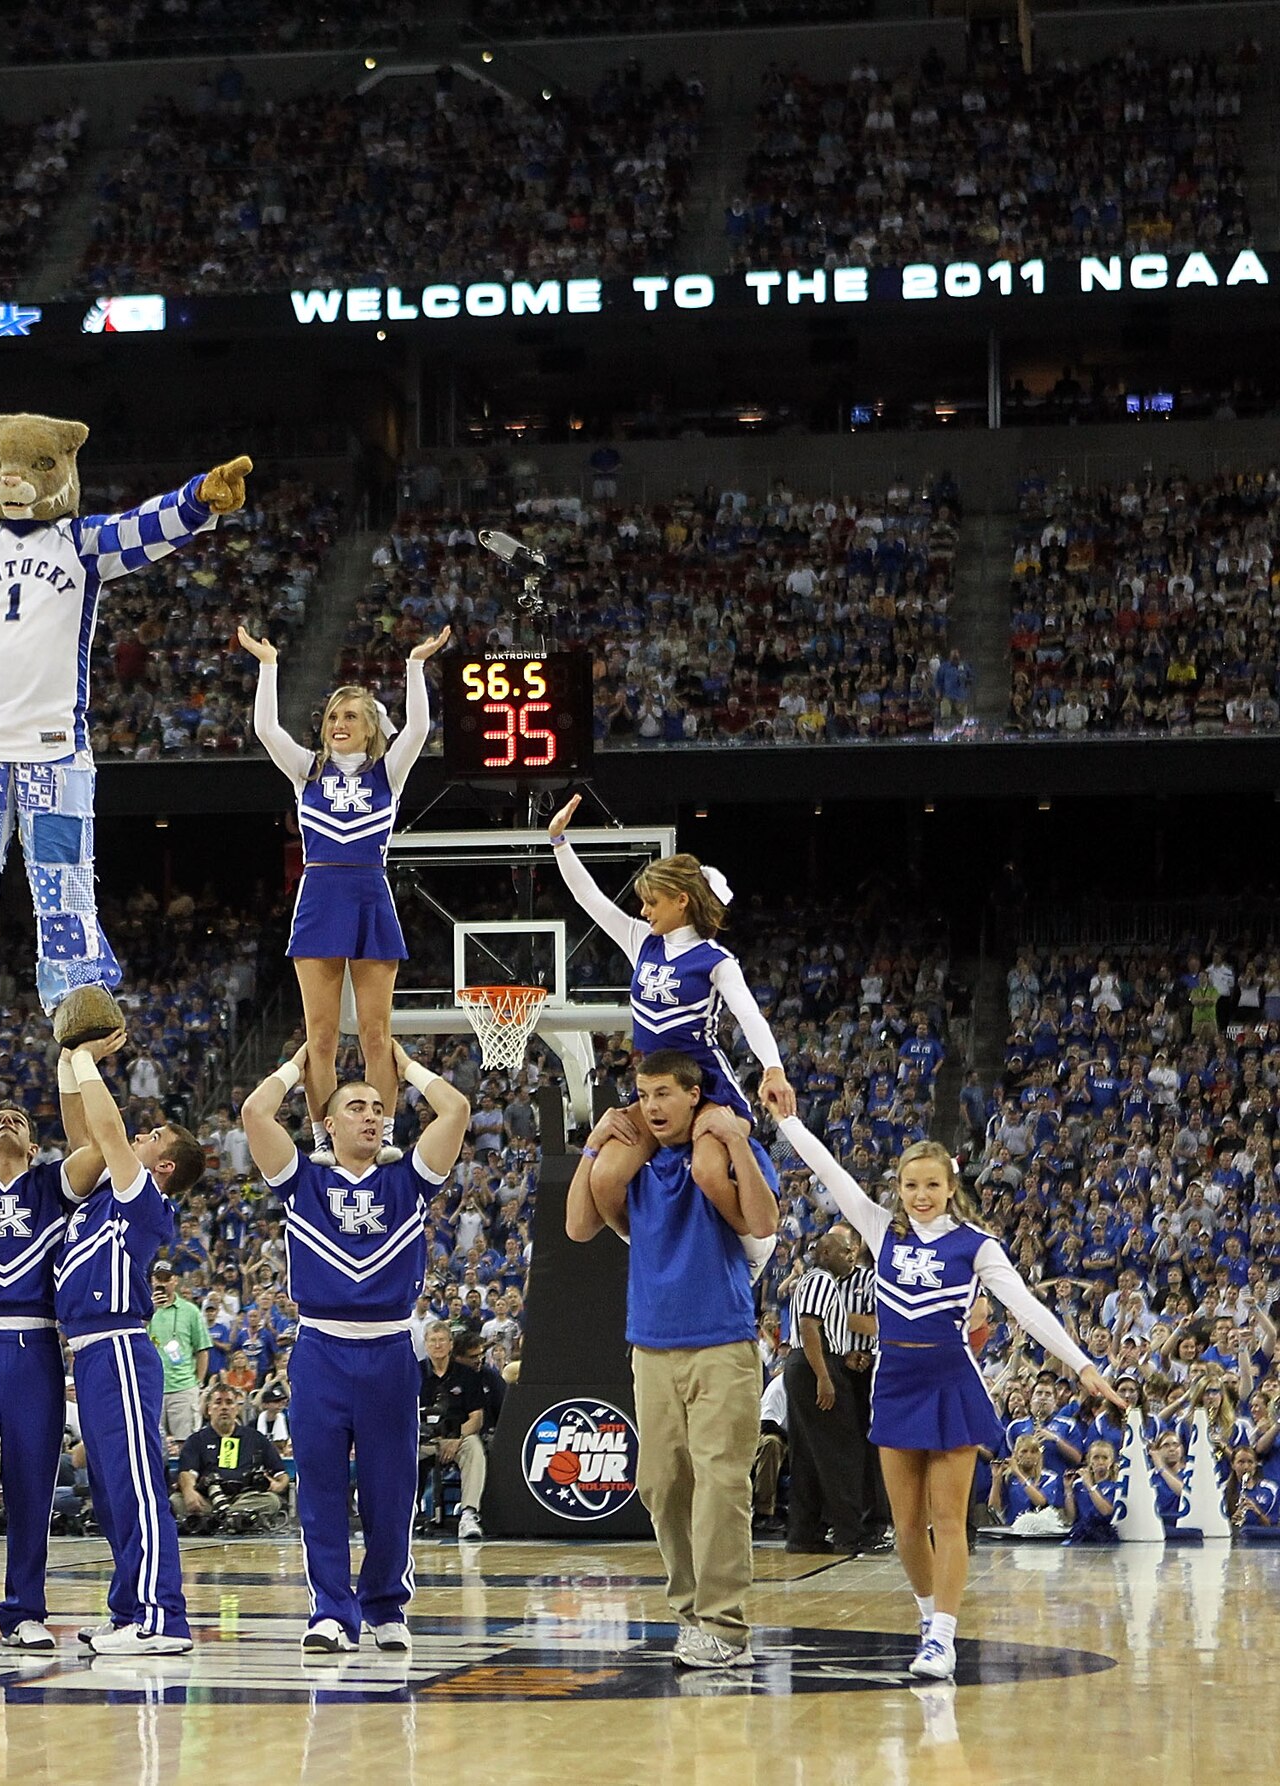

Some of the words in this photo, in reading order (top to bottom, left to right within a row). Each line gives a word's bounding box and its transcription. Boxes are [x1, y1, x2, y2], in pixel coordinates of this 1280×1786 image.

[291, 278, 602, 323] WELCOME
[633, 274, 715, 310] TO
[745, 266, 868, 304] THE
[902, 258, 1045, 300] 2011
[1080, 249, 1270, 293] NCAA
[5, 583, 22, 621] 1
[485, 652, 548, 660] DAKTRONICS
[462, 662, 547, 700] 56.5
[483, 702, 557, 767] 35
[322, 776, 372, 813] UK
[638, 962, 681, 1005] UK
[327, 1188, 388, 1235] UK
[891, 1244, 945, 1289] UK
[556, 1425, 628, 1452] FINAL
